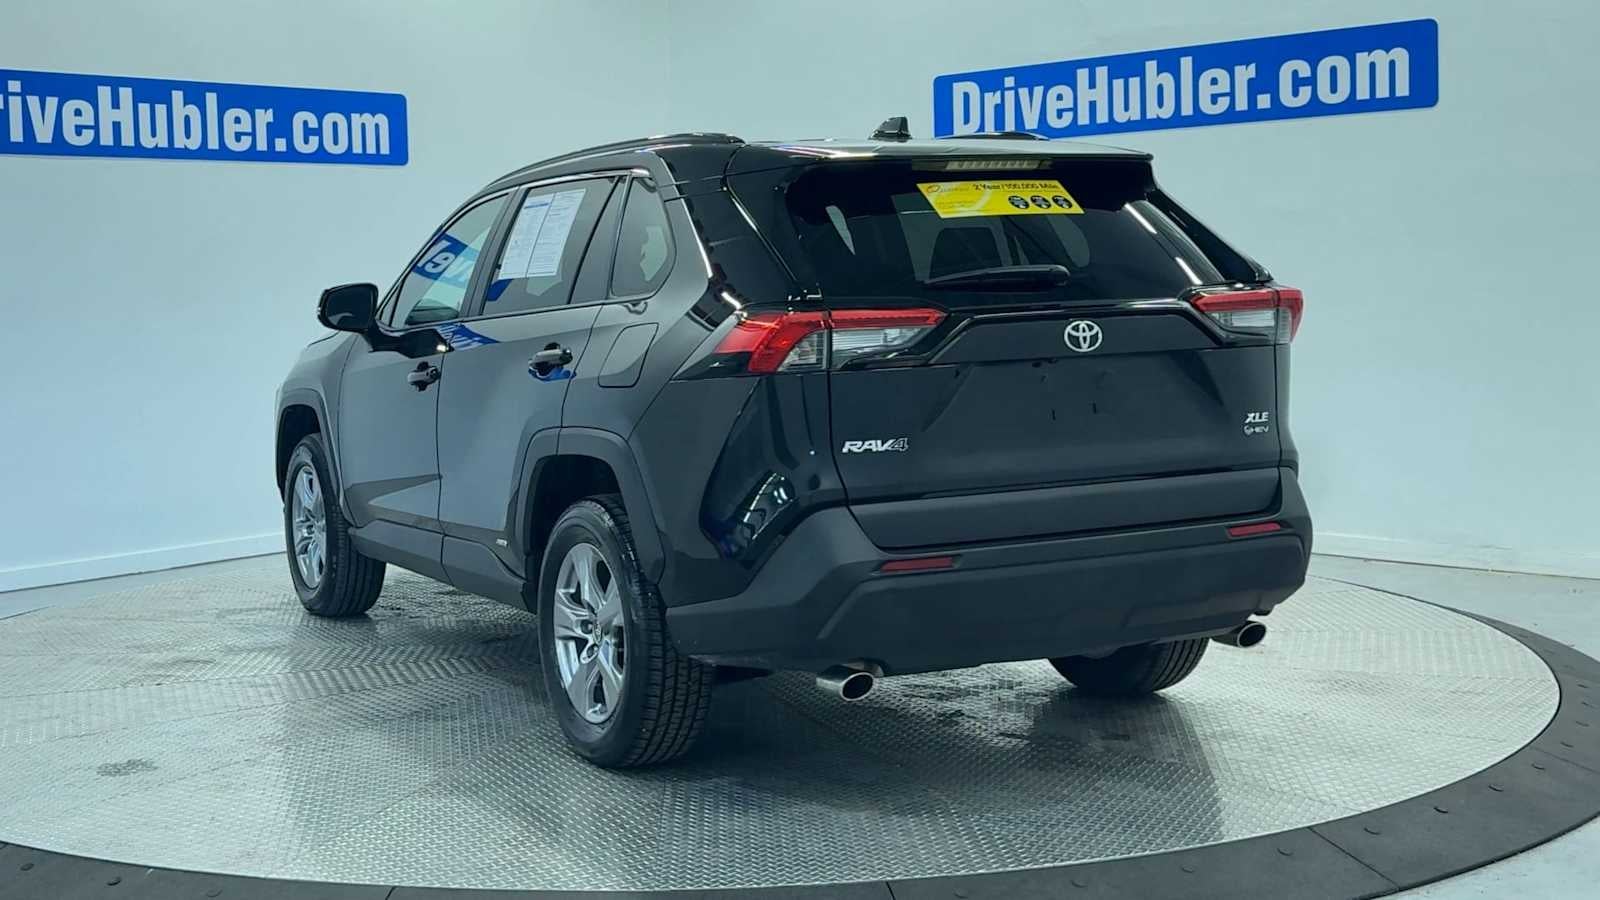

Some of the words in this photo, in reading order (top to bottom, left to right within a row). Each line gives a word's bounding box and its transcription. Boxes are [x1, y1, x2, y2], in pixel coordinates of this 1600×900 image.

[952, 46, 1410, 136] DriveHubler.com
[0, 80, 391, 155] iveHubler.com
[1244, 411, 1269, 423] XLE
[842, 437, 908, 453] RAV4
